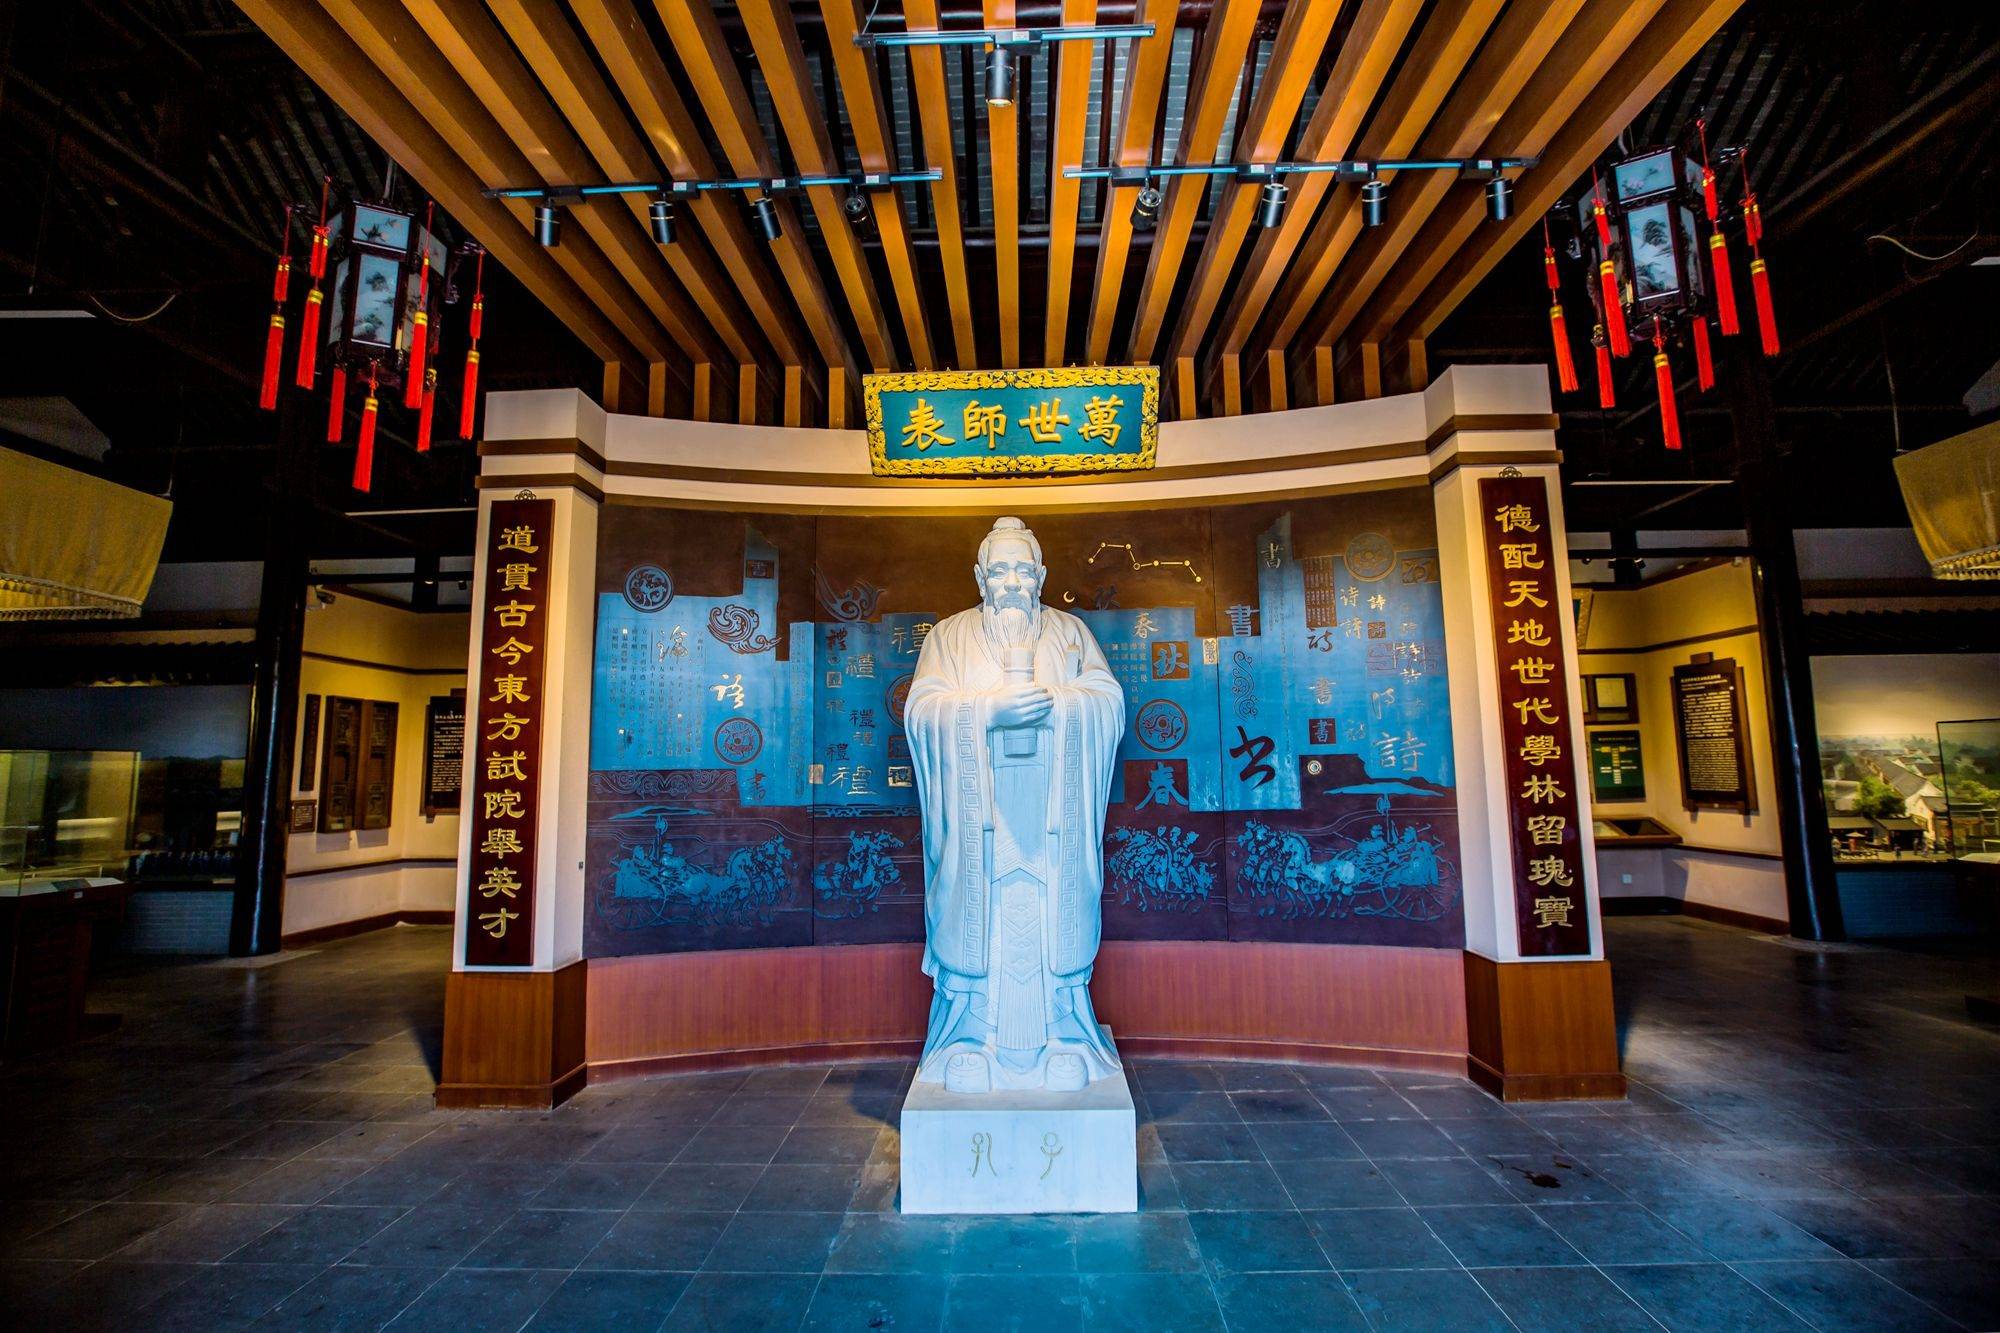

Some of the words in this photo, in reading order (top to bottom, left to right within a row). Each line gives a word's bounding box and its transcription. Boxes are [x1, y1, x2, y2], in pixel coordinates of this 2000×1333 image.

[902, 394, 1124, 450] 萬世師表
[478, 525, 539, 938] 道貫古今東方試院舉英才
[1135, 762, 1188, 811] 春
[1495, 504, 1573, 928] 德配天地世代學林留瑰寶
